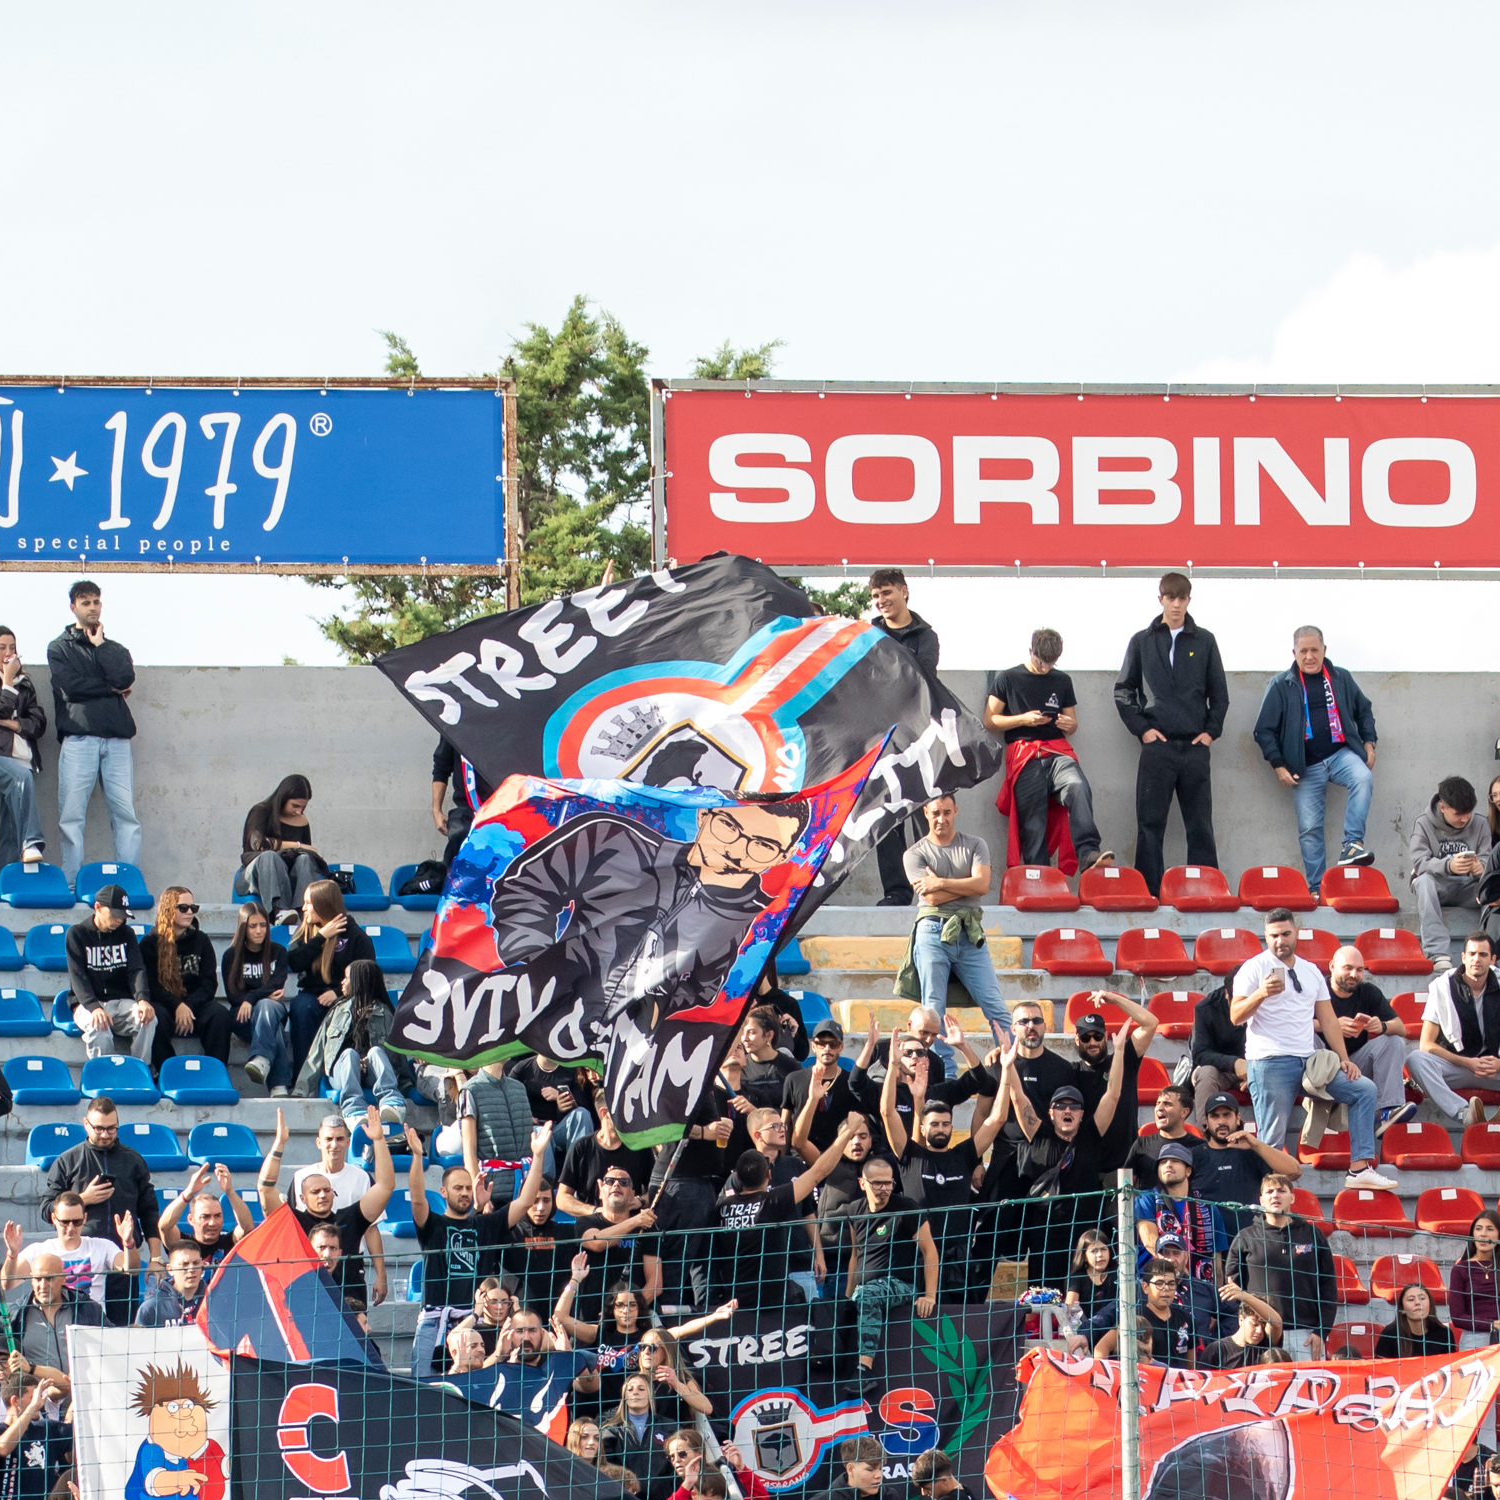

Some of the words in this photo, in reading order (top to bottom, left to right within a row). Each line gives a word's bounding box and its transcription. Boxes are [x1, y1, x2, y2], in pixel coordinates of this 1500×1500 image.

[99, 410, 300, 531] 1979
[708, 433, 1477, 528] SORBINO
[17, 534, 120, 554] special
[139, 535, 231, 555] people
[405, 568, 687, 725] STREE
[597, 1354, 616, 1368] 980
